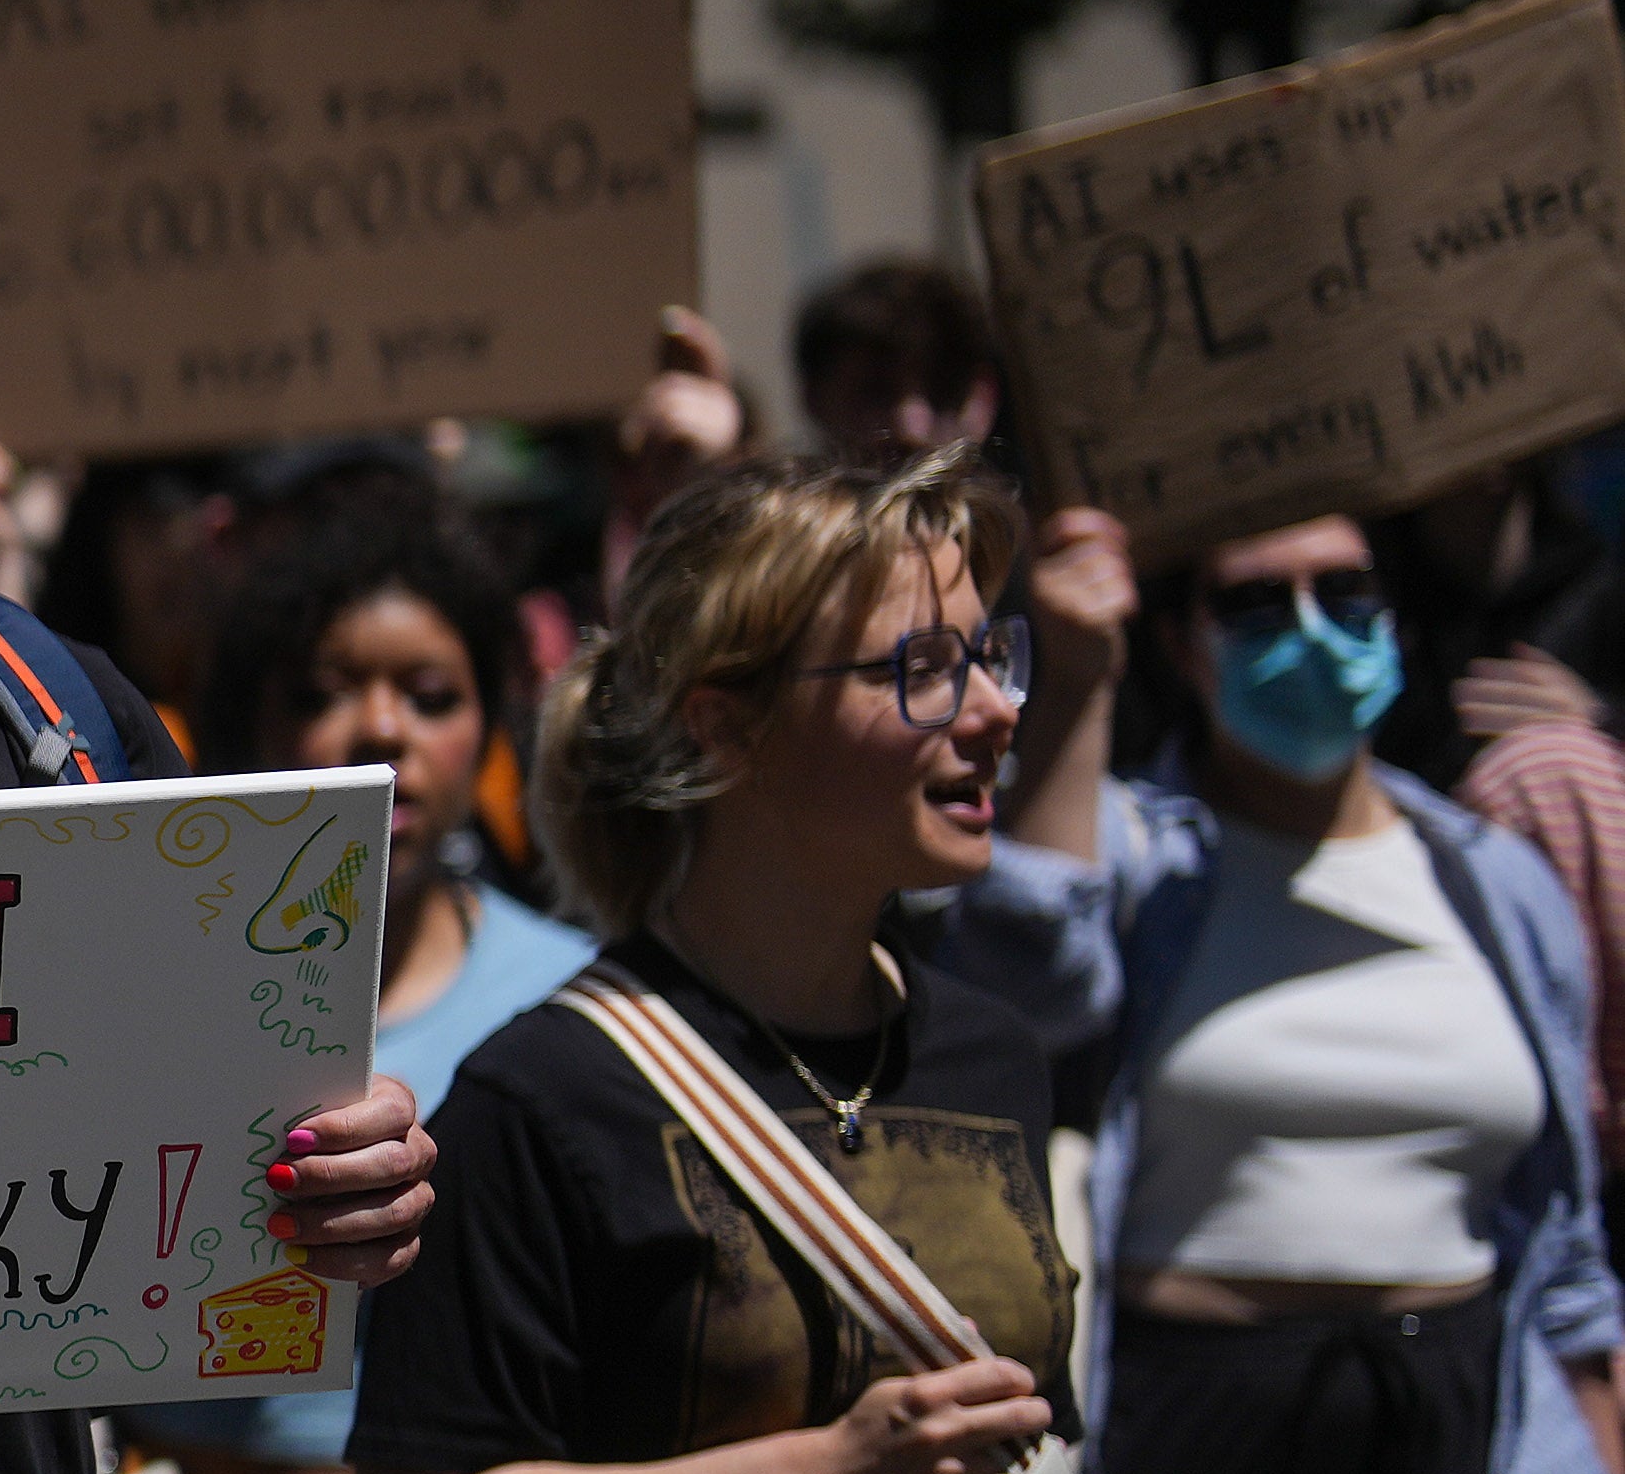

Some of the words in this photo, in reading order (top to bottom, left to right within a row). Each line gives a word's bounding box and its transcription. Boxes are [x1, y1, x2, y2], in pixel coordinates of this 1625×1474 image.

[1018, 158, 1105, 265] AI
[1150, 135, 1285, 199] uses
[1336, 95, 1407, 140] up
[1422, 59, 1475, 105] to
[1308, 196, 1374, 313] of
[1216, 394, 1387, 486] every
